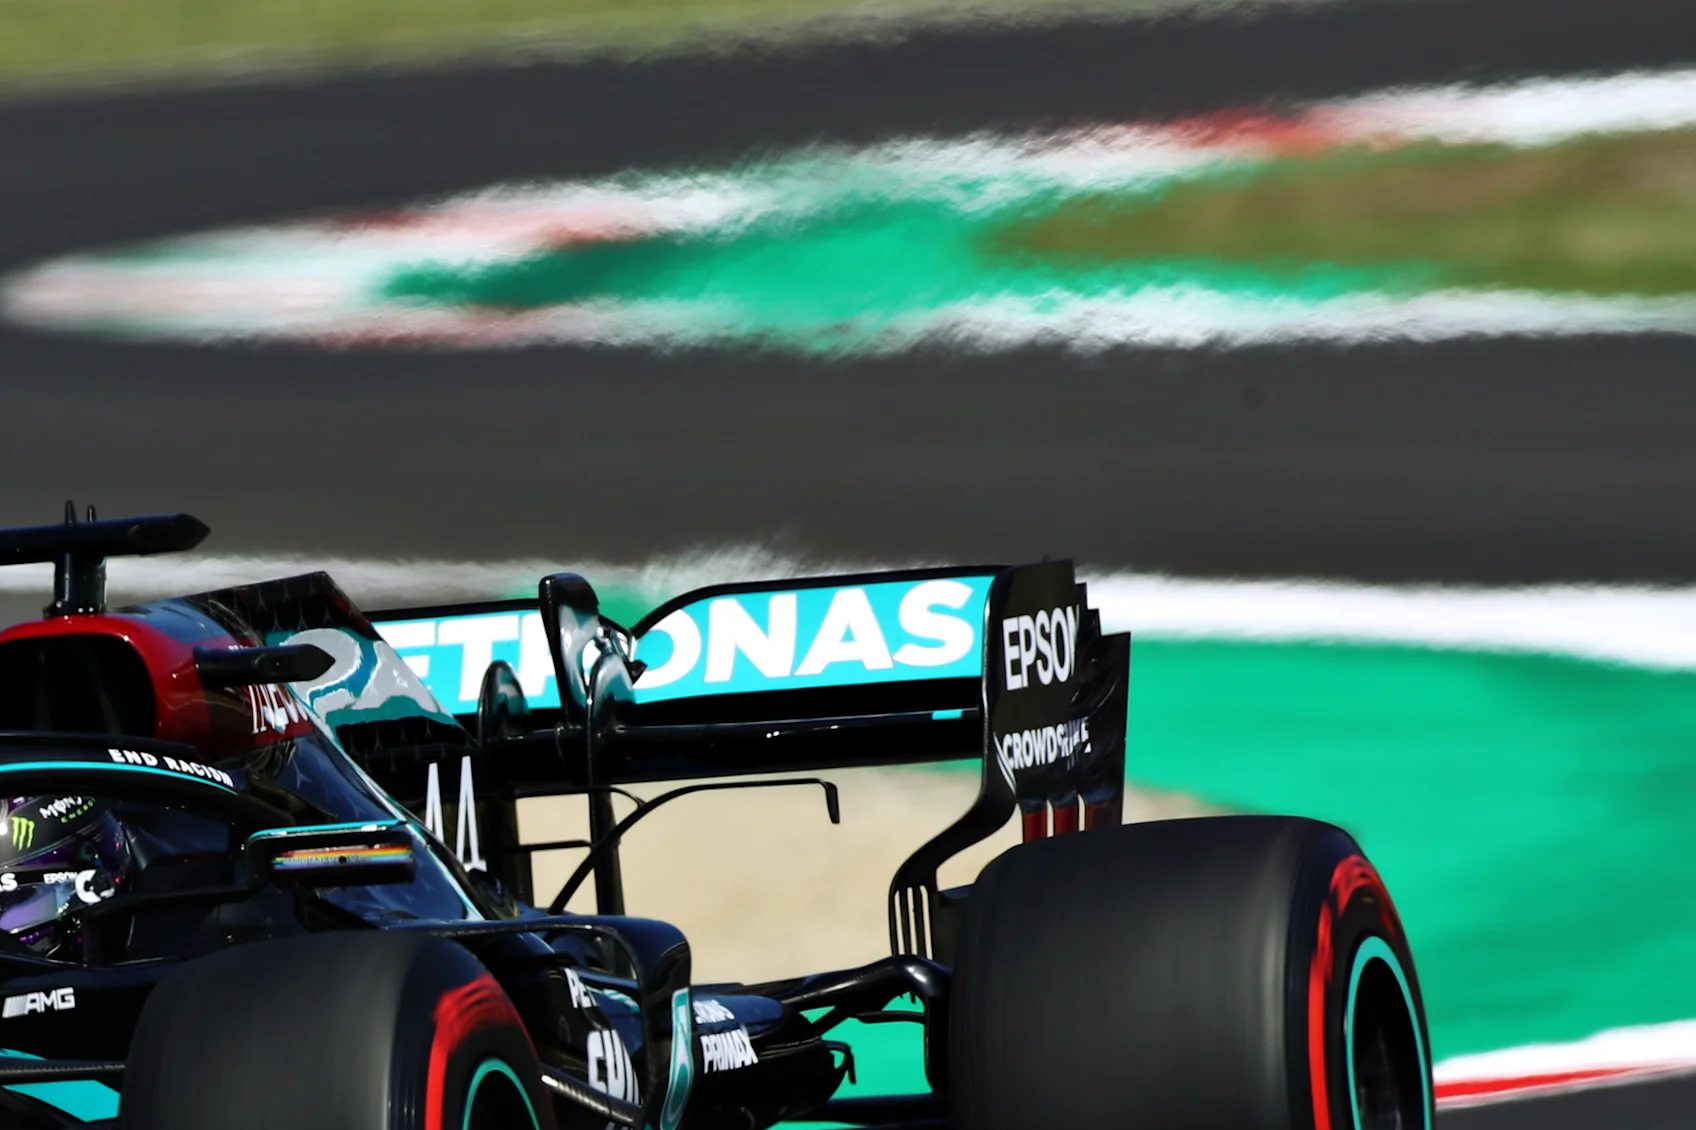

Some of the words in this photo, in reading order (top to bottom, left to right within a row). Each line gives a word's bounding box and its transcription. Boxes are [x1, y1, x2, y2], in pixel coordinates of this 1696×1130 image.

[376, 579, 974, 701] ETRONAS
[1003, 604, 1080, 691] EPSON
[108, 749, 158, 766] END
[163, 756, 234, 788] RACISM
[21, 986, 76, 1015] AMG
[700, 1024, 759, 1074] PRIMAX
